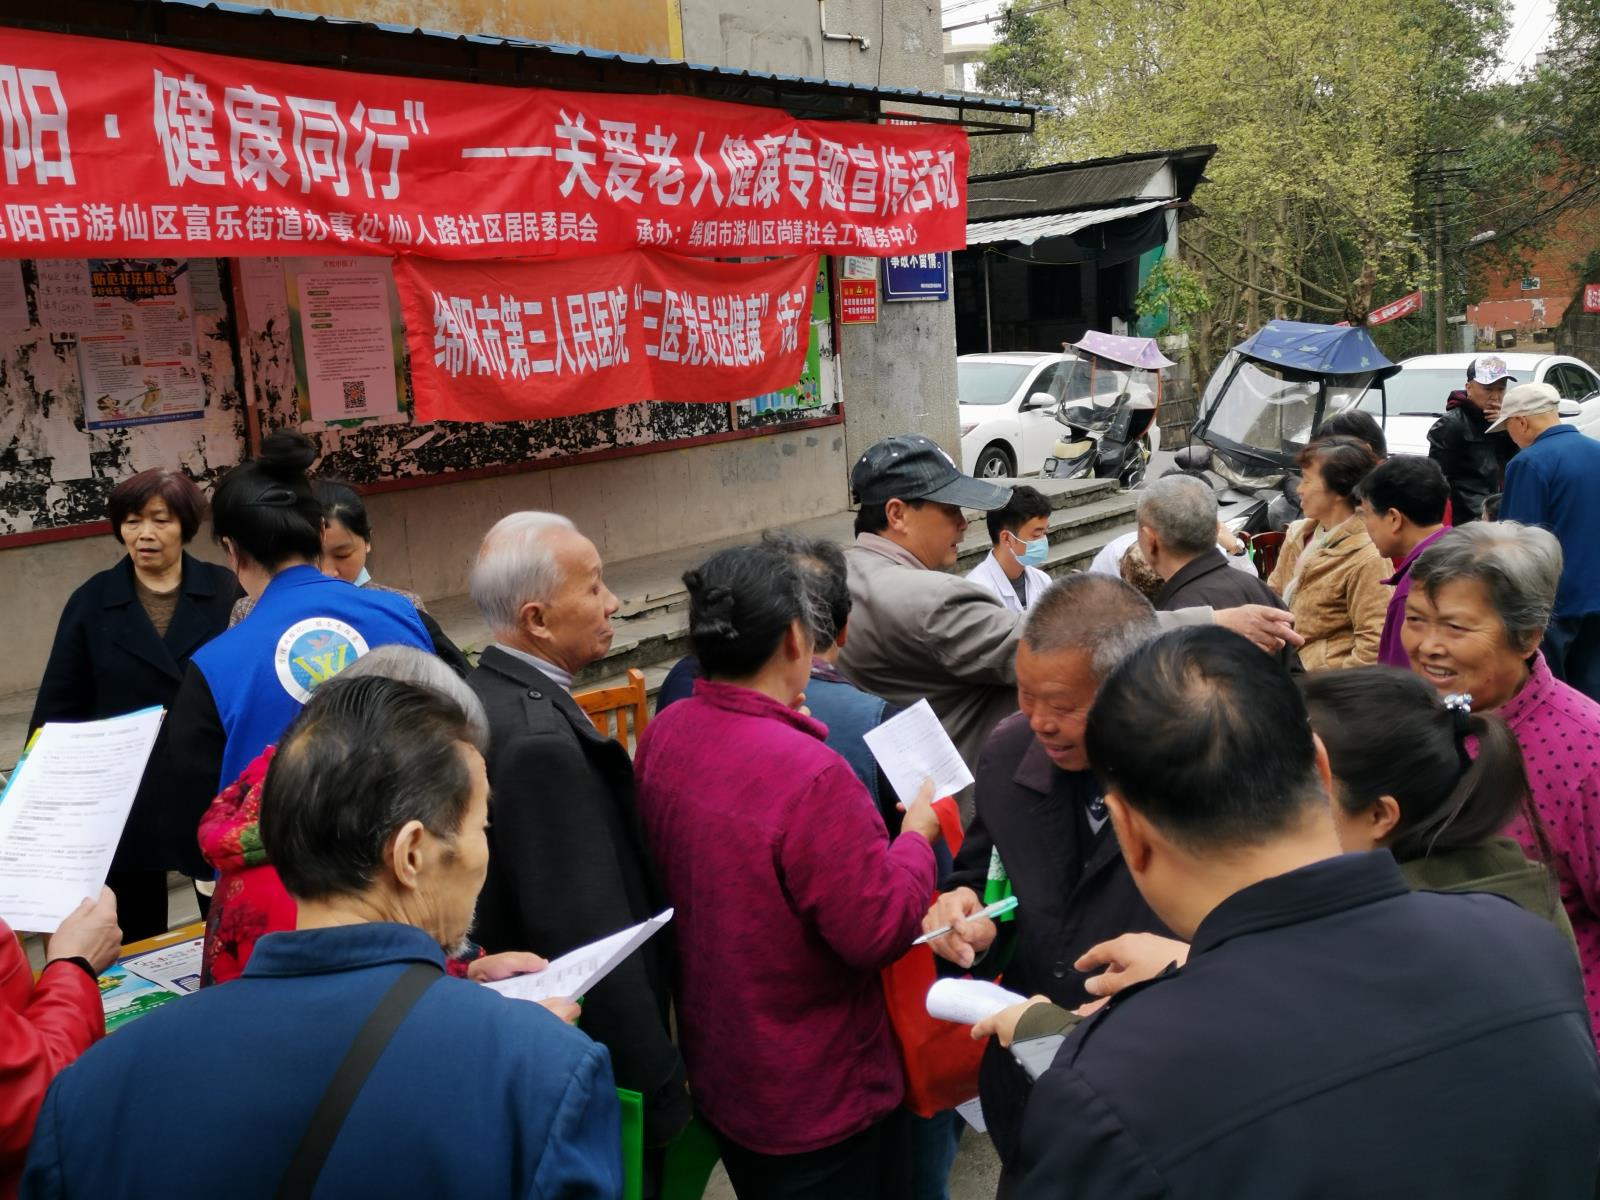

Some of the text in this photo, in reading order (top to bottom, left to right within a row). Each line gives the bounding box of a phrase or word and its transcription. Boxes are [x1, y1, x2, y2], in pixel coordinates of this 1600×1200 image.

[0, 203, 598, 246] 阳市游仙区富乐街道办事处仙人路社区居民委员会
